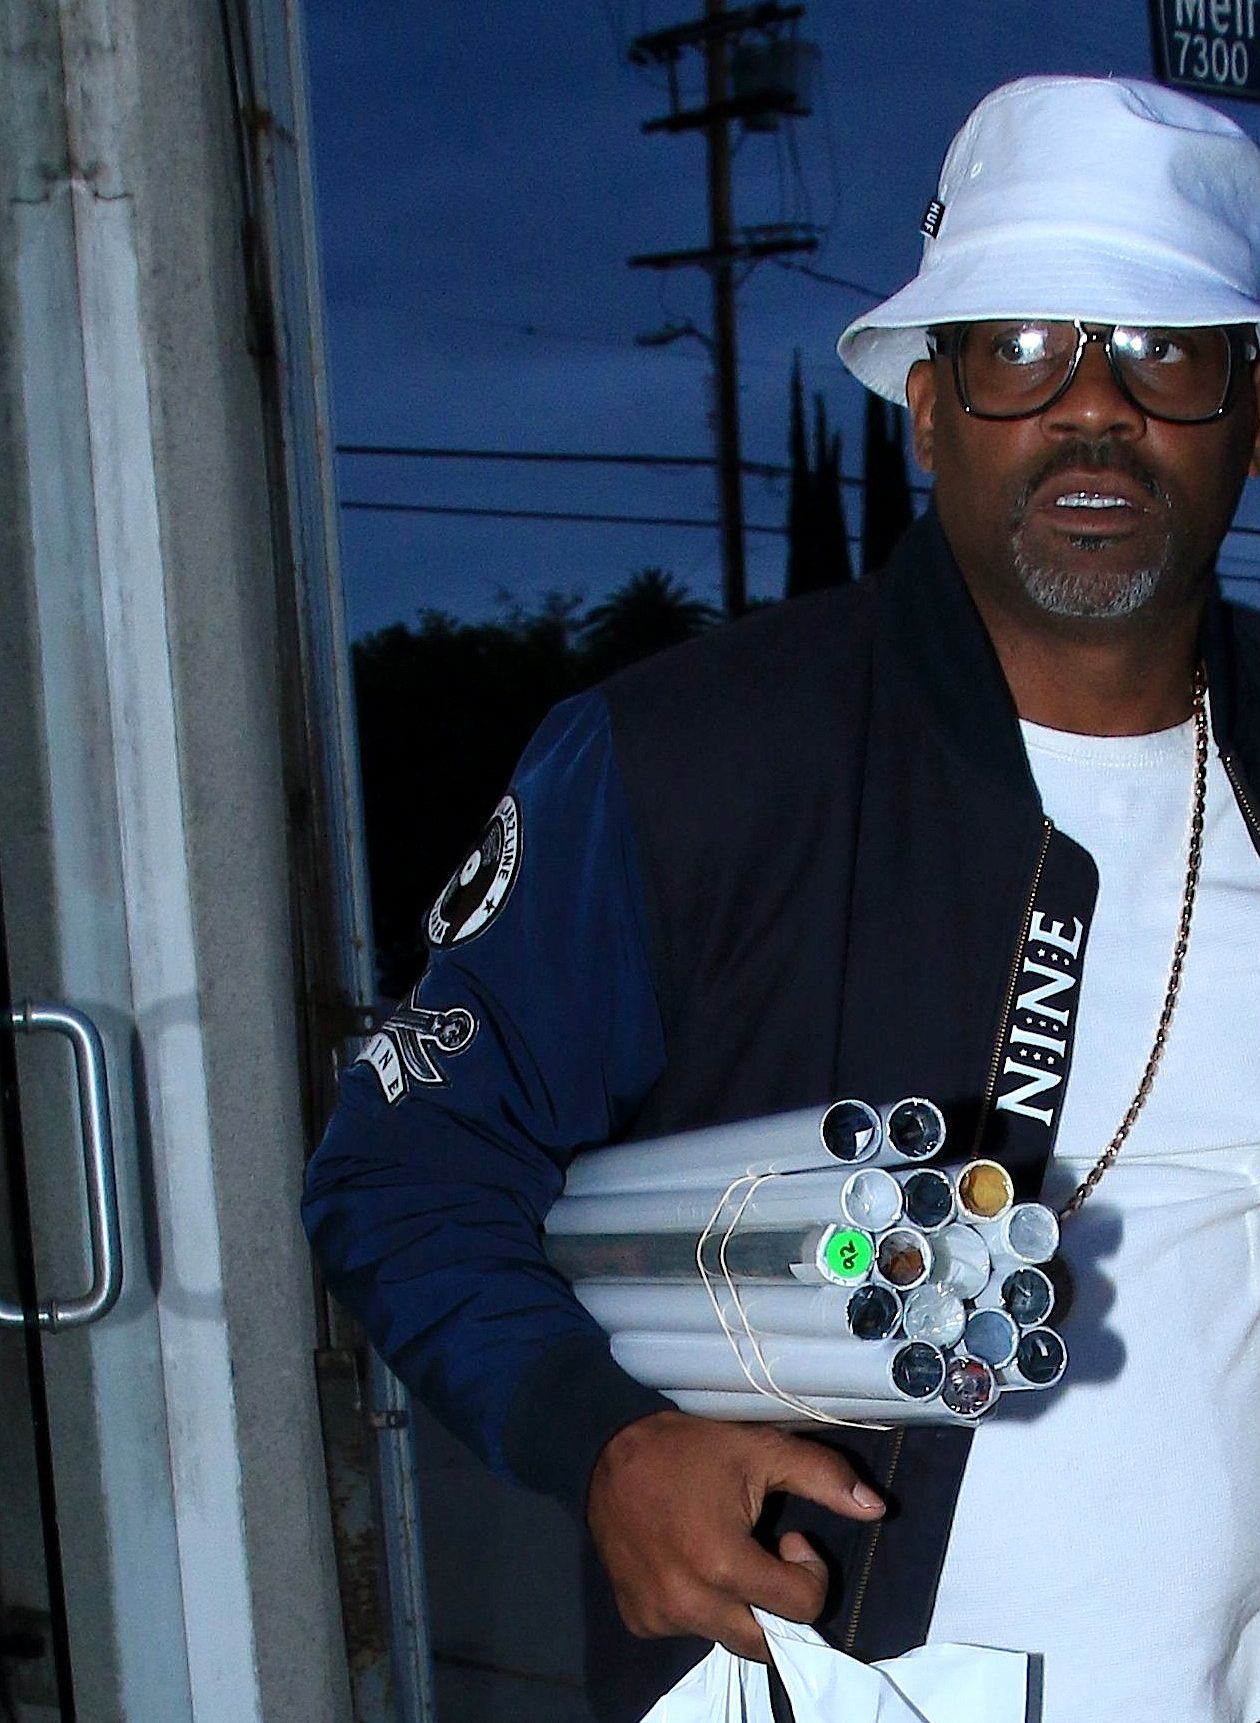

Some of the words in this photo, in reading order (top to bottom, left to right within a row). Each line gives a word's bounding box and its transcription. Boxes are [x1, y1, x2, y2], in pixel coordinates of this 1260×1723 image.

[1174, 31, 1249, 86] 7300
[924, 202, 941, 234] HUF
[996, 910, 1083, 1126] NINE
